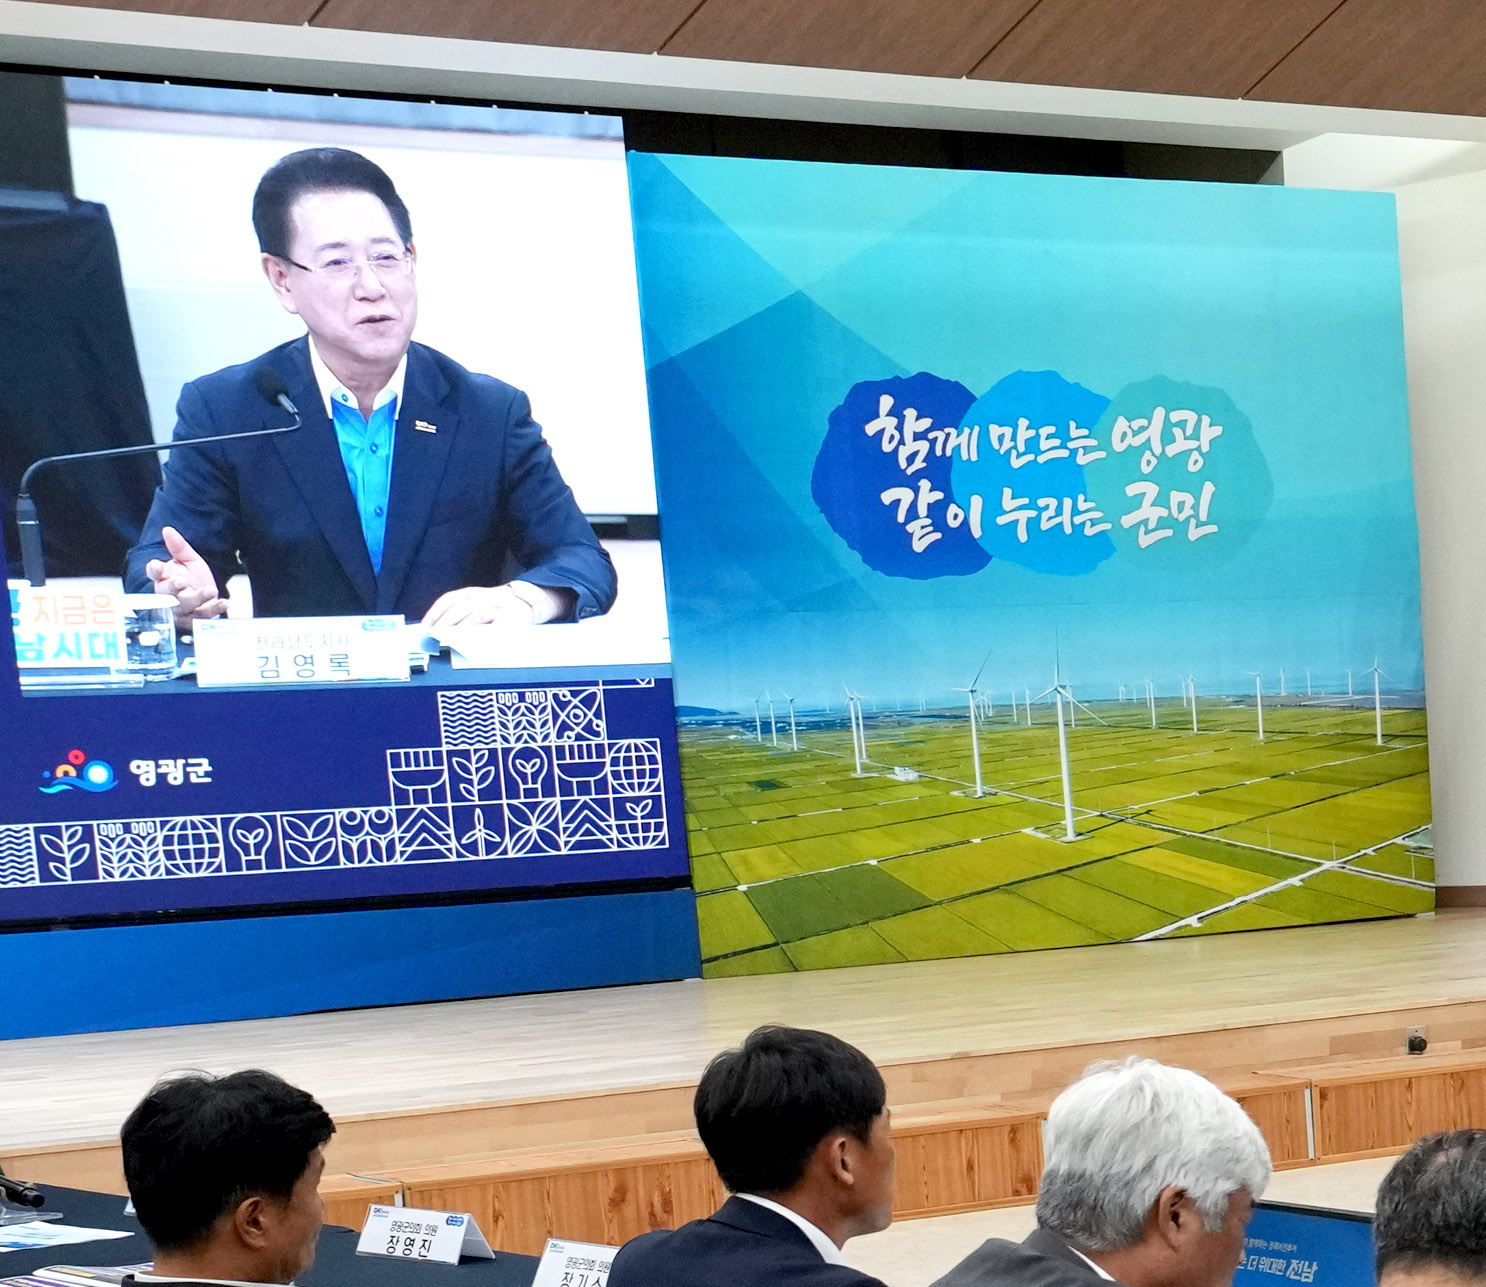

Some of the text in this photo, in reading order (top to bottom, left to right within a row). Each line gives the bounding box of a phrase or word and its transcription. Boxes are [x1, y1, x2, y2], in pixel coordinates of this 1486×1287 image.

[865, 394, 1224, 475] 함께 만드는 영광
[880, 479, 1220, 553] 같이 누리는 군민
[32, 594, 116, 625] 지금은
[256, 652, 351, 680] 김영록
[129, 757, 213, 787] 영광군
[390, 1220, 438, 1236] 영광군의회 의원
[386, 1235, 432, 1258] 장영진
[565, 1256, 597, 1271] 영광군의회
[1247, 1255, 1259, 1271] 더
[1258, 1256, 1286, 1275] 위대한
[1286, 1259, 1318, 1283] 전남
